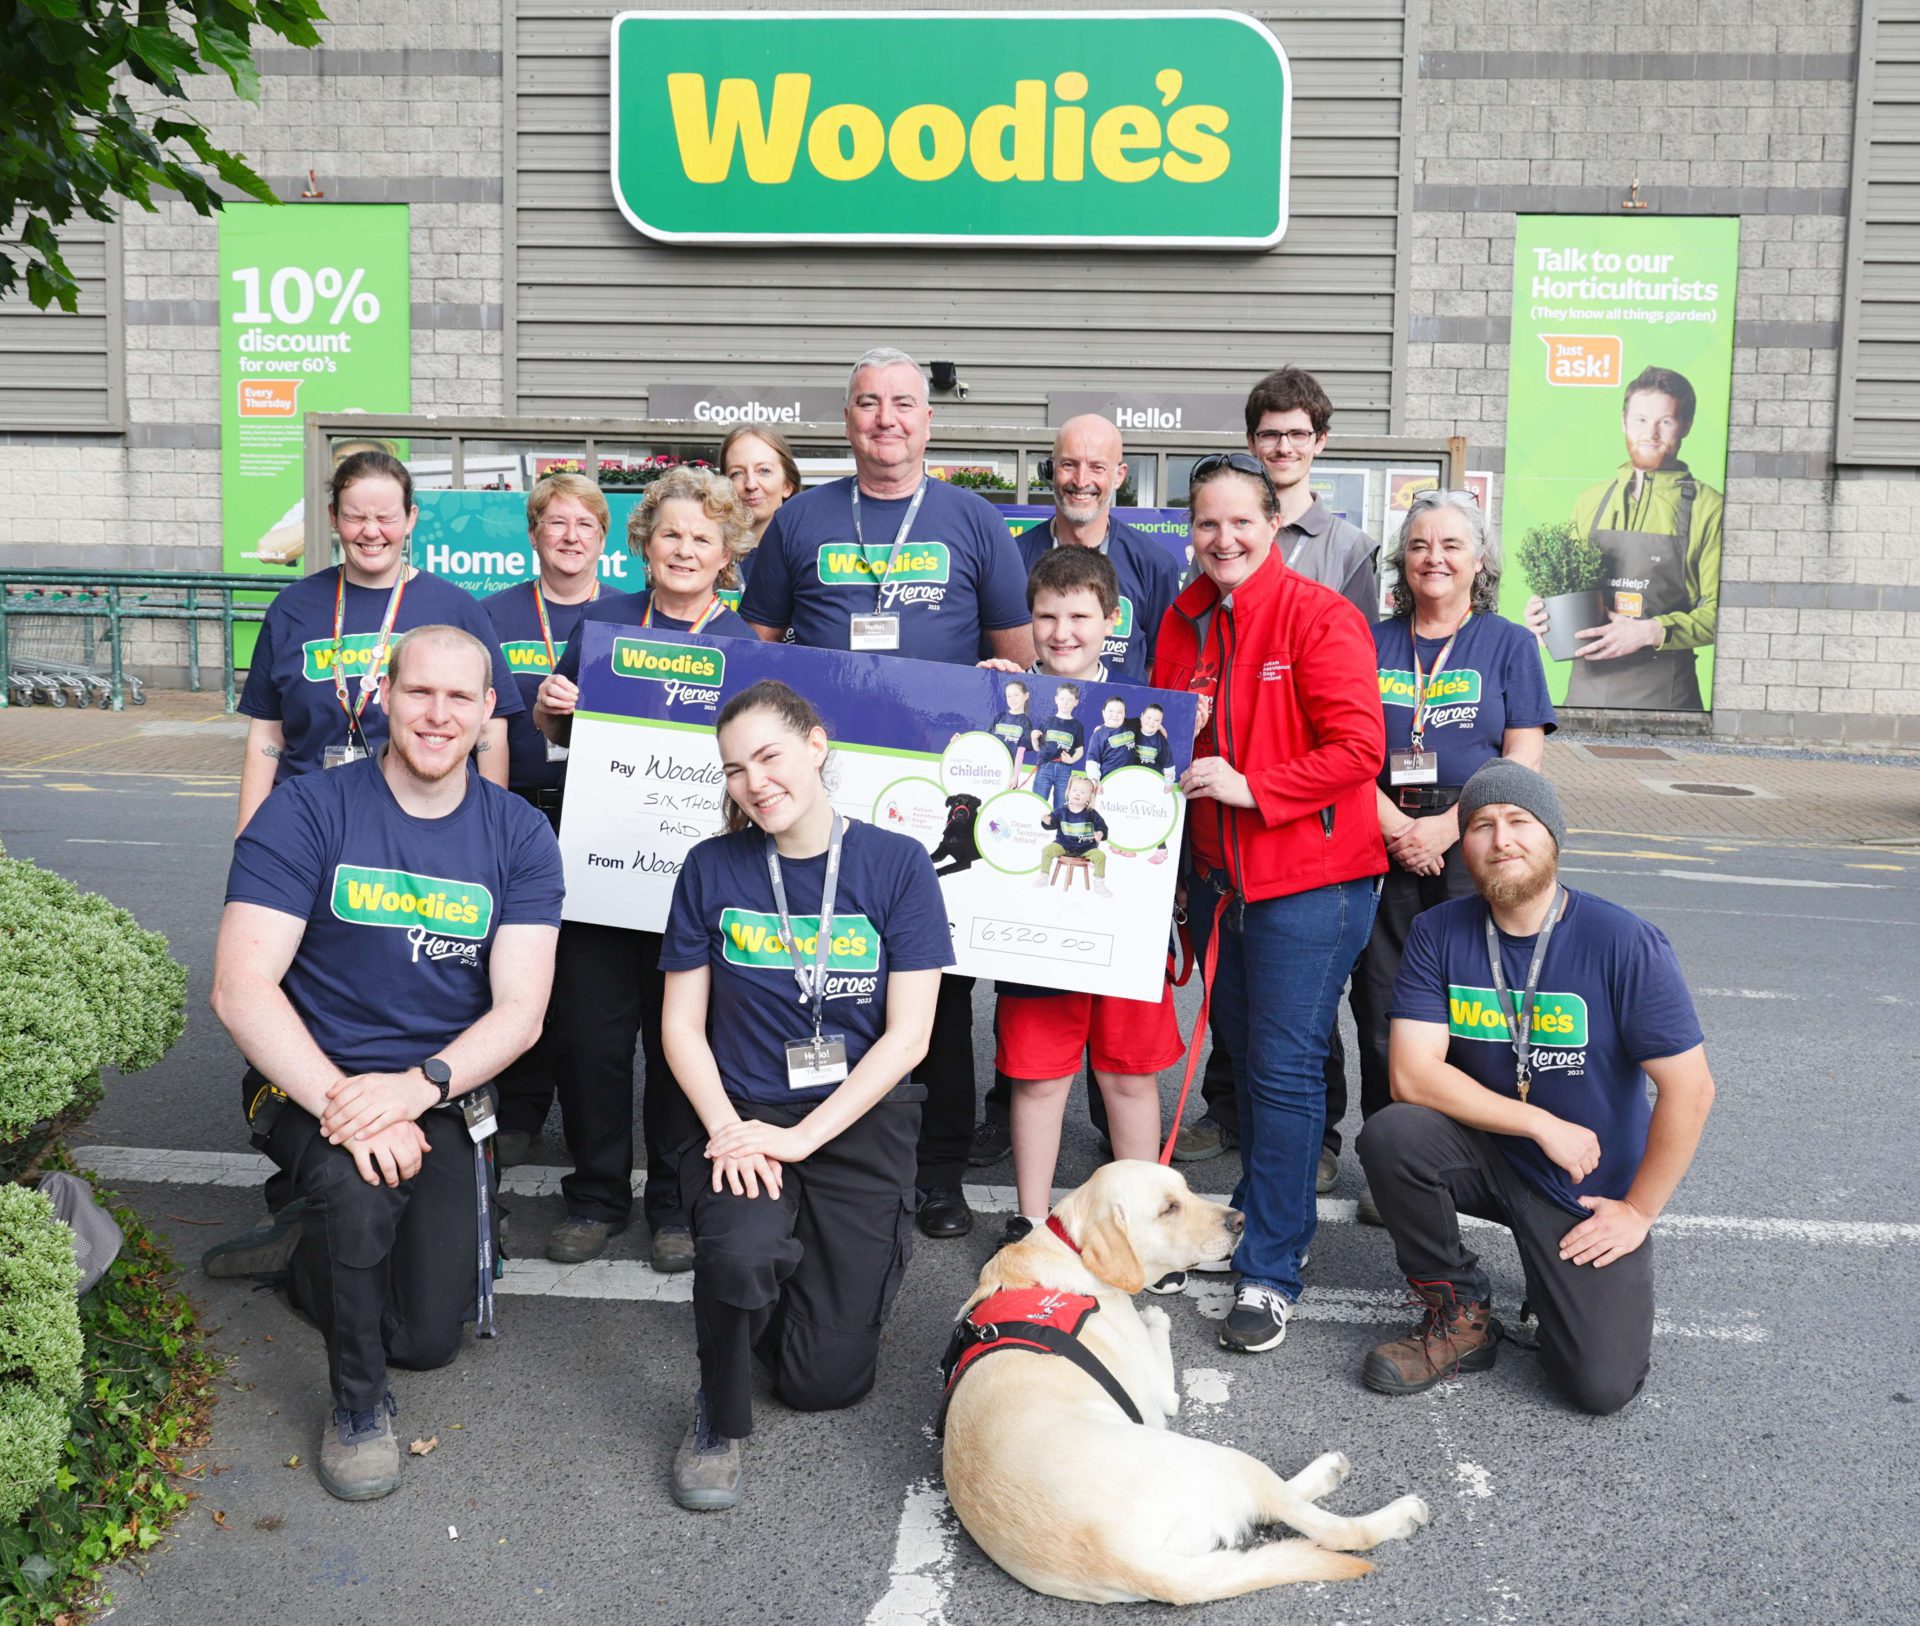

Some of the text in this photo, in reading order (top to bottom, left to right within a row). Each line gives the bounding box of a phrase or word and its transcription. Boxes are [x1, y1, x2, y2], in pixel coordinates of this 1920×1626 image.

[666, 68, 1231, 184] Woodie's
[1532, 247, 1675, 274] Talk to our
[232, 266, 381, 325] 10%
[1531, 275, 1719, 302] Horticulturists
[1530, 305, 1718, 324] (They know all things garden)
[238, 328, 352, 353] discount
[1555, 344, 1584, 357] Just
[239, 356, 337, 373] for over 60's
[1555, 354, 1611, 379] ask!
[244, 387, 273, 400] Every
[244, 398, 292, 410] Thursday
[694, 401, 801, 422] Goodbye!
[1116, 407, 1182, 429] Hello!
[426, 544, 525, 576] Home
[1608, 578, 1651, 590] ed Help?
[881, 580, 947, 608] Heroes
[1101, 640, 1129, 654] roes
[622, 647, 715, 676] Woodie's
[664, 678, 721, 706] Heroes
[610, 760, 636, 778] Pay
[949, 764, 1002, 778] Childline
[643, 792, 679, 810] SIX
[1100, 801, 1128, 814] Make
[659, 820, 701, 838] AND
[1011, 820, 1032, 829] Down
[1013, 836, 1037, 845] Ireland
[1016, 828, 1051, 840] Syndrome
[588, 853, 625, 870] From
[347, 880, 480, 924] Woodie's
[407, 924, 482, 963] Heroes
[1060, 938, 1096, 951] 00
[460, 958, 478, 967] 2023
[856, 997, 873, 1005] 2023
[804, 1050, 830, 1061] Helo!
